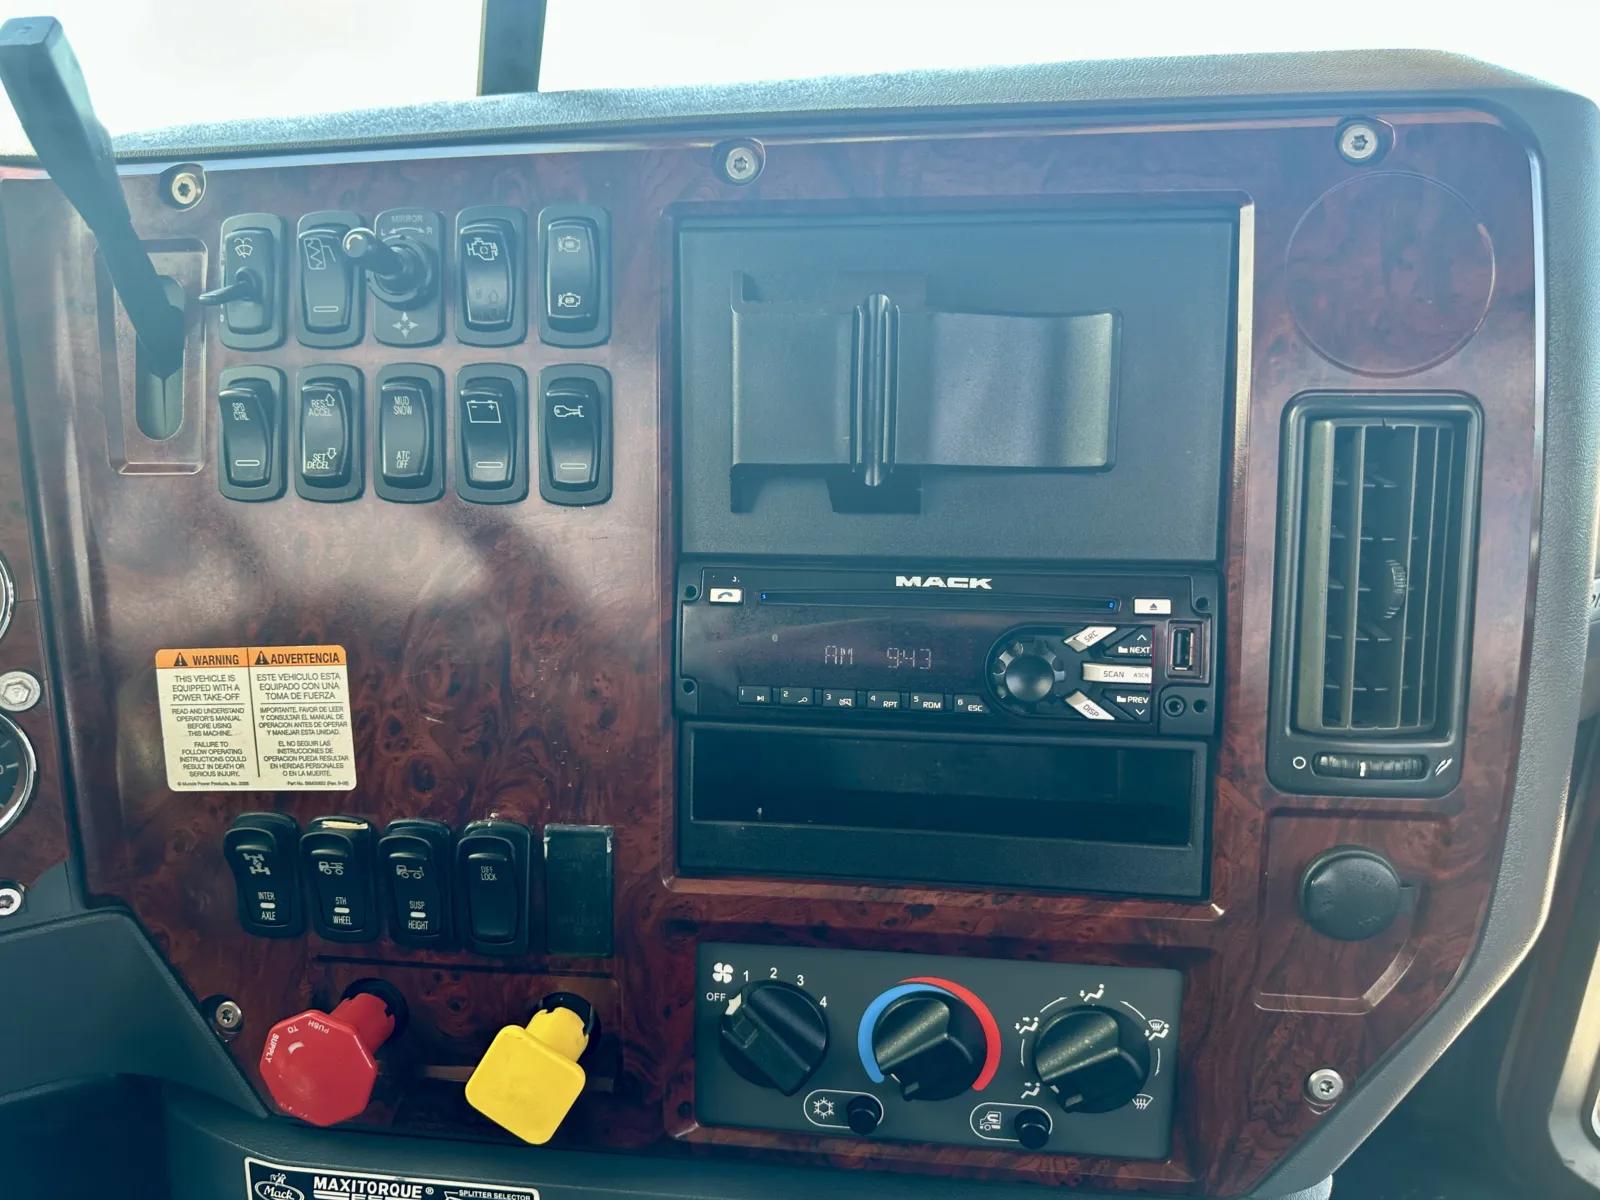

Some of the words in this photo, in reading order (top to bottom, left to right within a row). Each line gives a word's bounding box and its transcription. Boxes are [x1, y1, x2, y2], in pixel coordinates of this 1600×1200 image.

[394, 396, 410, 406] MUD
[308, 408, 332, 416] ACCEL
[394, 405, 412, 415] SNOW
[312, 454, 326, 462] SET
[396, 451, 410, 460] ATC
[307, 461, 330, 470] DECEL
[396, 460, 408, 468] OFF
[896, 576, 992, 590] MACK
[1084, 630, 1098, 642] SRC
[271, 653, 340, 664] ADVERTENCIA
[825, 646, 853, 664] AM
[192, 655, 239, 666] WARNING
[1082, 704, 1100, 716] DISP
[261, 912, 276, 920] AXLE
[333, 916, 352, 925] WHEEL
[408, 920, 428, 930] HEIGHT
[744, 970, 749, 982] 1
[770, 967, 778, 979] 2
[797, 975, 804, 986] 3
[706, 992, 726, 1002] OFF
[820, 996, 827, 1008] 4
[288, 1024, 299, 1033] TO
[265, 1033, 280, 1064] SUPPLY
[313, 1176, 423, 1199] MAXITORQUE
[264, 1186, 295, 1200] Mack
[459, 1190, 492, 1198] SPLITTER
[494, 1192, 530, 1200] SELECTOR
